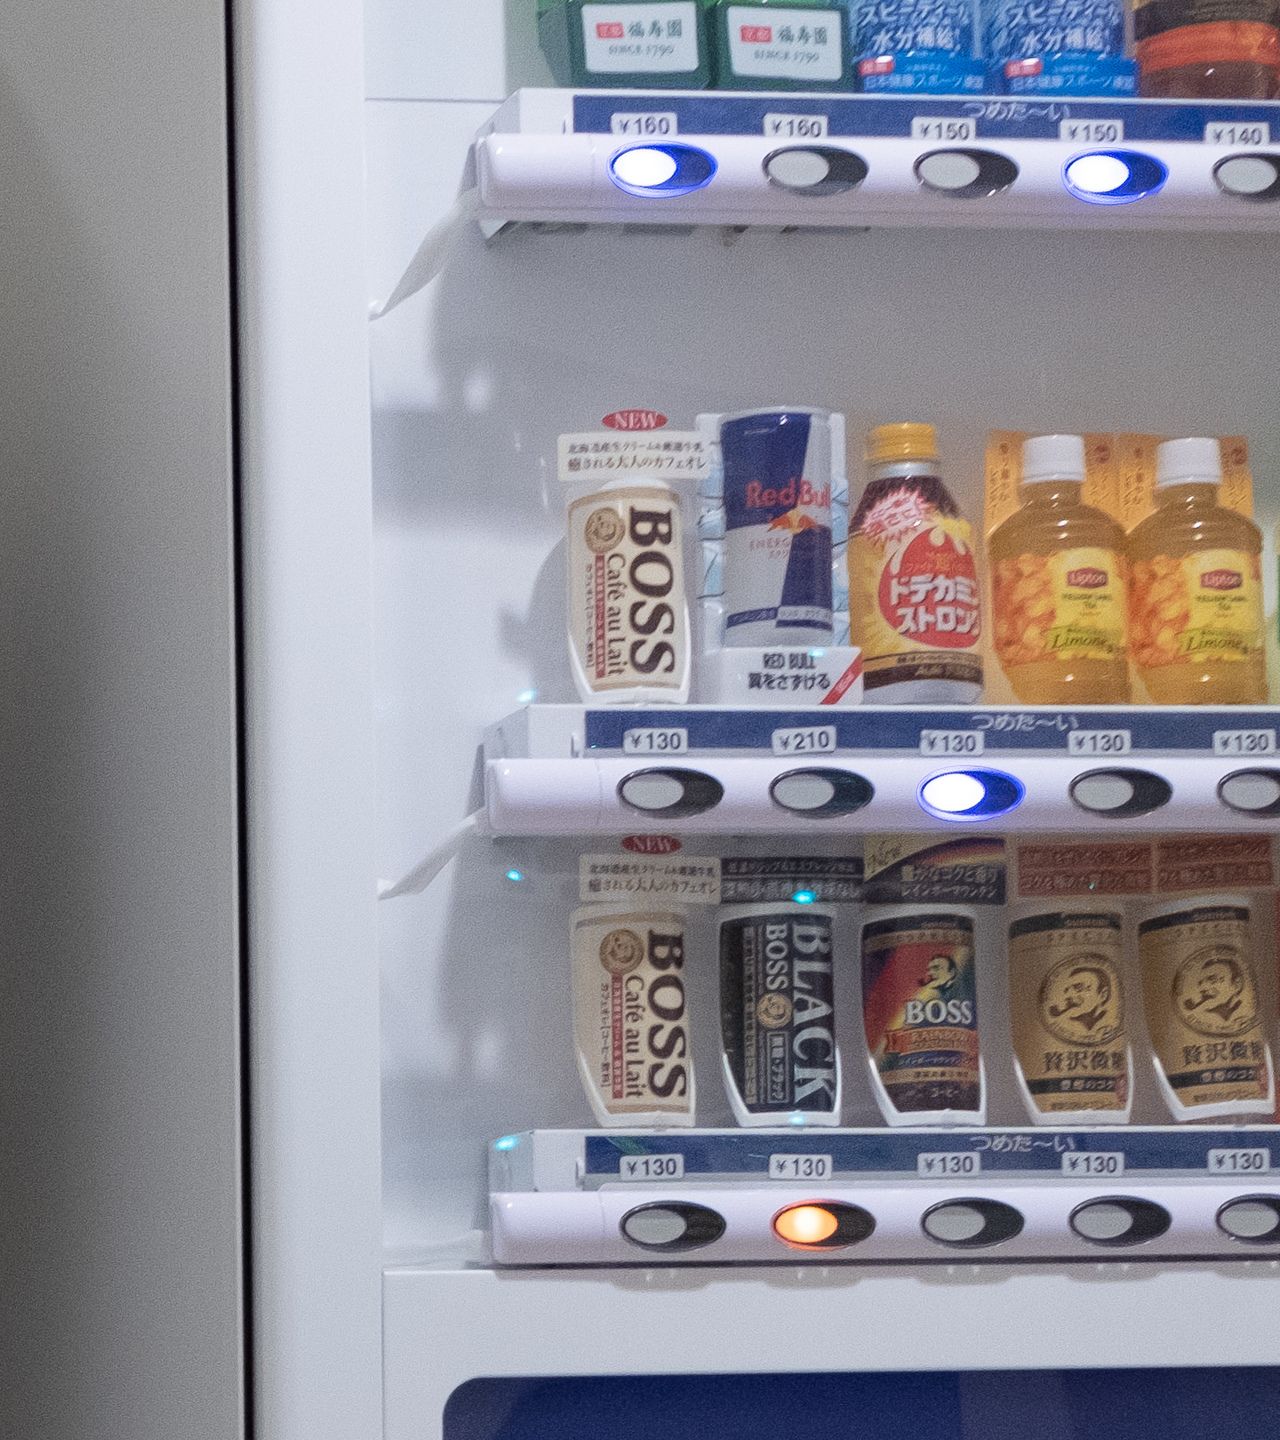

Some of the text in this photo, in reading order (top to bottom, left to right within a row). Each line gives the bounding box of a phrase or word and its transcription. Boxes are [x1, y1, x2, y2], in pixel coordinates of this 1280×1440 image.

[619, 116, 671, 136] ¥160
[771, 119, 822, 138] ¥160
[919, 121, 971, 141] ¥150
[1068, 123, 1118, 143] ¥150
[1213, 125, 1263, 146] ¥140
[614, 412, 658, 429] NEW
[628, 504, 676, 675] BOSS
[606, 552, 628, 676] Café au Lait
[748, 672, 831, 691] 翼をさずける
[631, 731, 682, 751] ¥130
[780, 730, 830, 751] ¥210
[926, 732, 977, 753] ¥130
[1074, 732, 1124, 752] ¥130
[1220, 731, 1269, 752] ¥130
[765, 923, 788, 991] BOSS
[647, 929, 687, 1098] BOSS
[792, 924, 834, 1104] BLACK
[905, 999, 973, 1024] BOSS
[624, 974, 645, 1099] Café au Lait
[626, 1156, 678, 1177] ¥130
[776, 1156, 826, 1177] ¥130
[923, 1154, 975, 1175] ¥130
[1069, 1154, 1118, 1175] ¥130
[1216, 1150, 1264, 1171] ¥130
